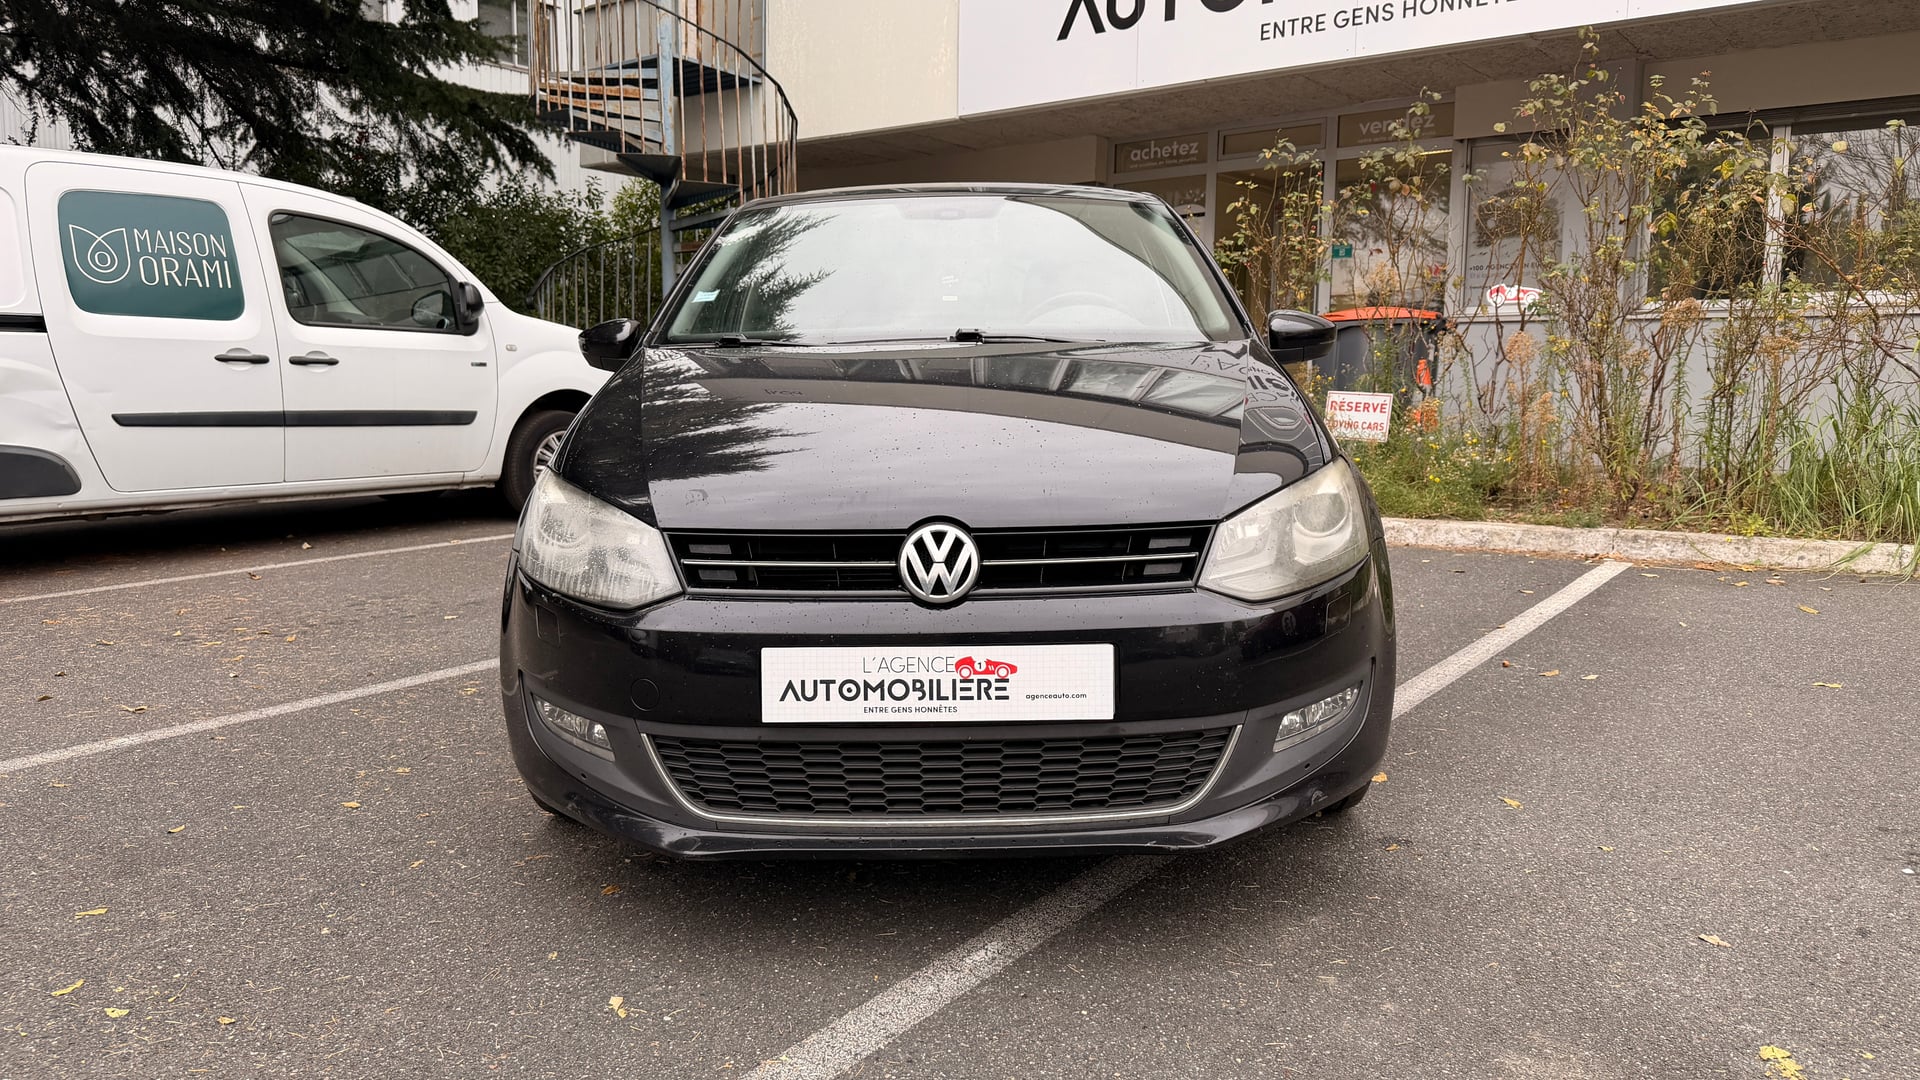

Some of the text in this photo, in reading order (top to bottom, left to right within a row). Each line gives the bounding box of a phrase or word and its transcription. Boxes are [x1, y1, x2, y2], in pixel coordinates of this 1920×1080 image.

[1260, 13, 1327, 41] ENTRE
[1333, 3, 1395, 29] GENS
[1130, 140, 1199, 161] achetez
[133, 228, 227, 258] MAISON
[139, 255, 232, 289] ORAMI
[1330, 398, 1388, 414] RÉSERVÉ
[1361, 421, 1385, 431] CARS
[863, 656, 955, 673] L'AGENCE
[1025, 693, 1087, 701] agenceauto.com
[863, 704, 958, 714] ENTRE GENS HONNÊTES
